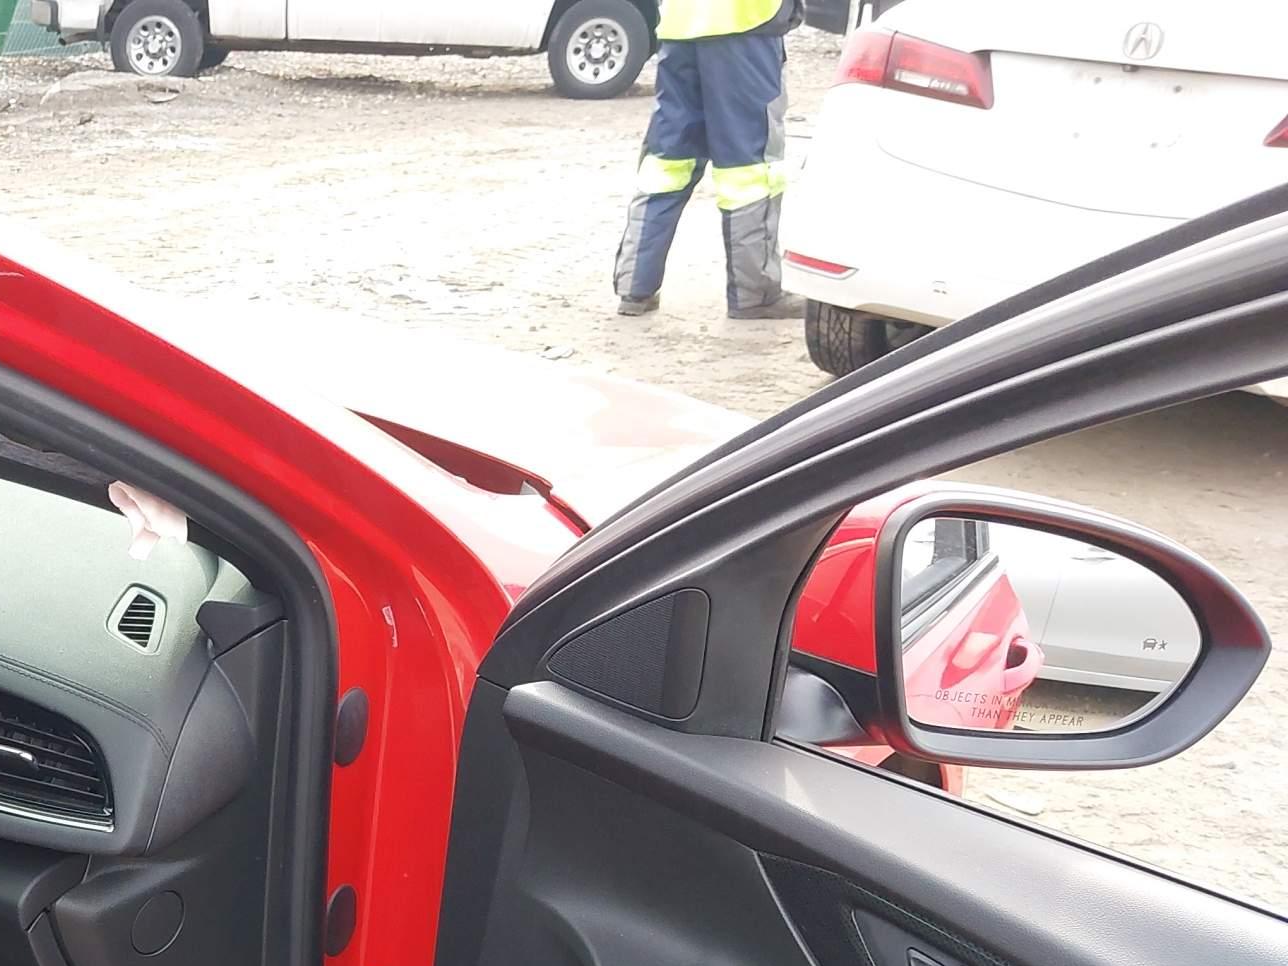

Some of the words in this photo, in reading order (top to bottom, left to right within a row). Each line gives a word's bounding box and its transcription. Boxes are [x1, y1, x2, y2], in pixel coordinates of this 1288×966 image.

[935, 689, 988, 704] OBJECTS
[991, 694, 1003, 706] IN
[971, 707, 1002, 720] THAN
[1005, 709, 1035, 722] THEY
[1040, 713, 1085, 727] APPEAR
